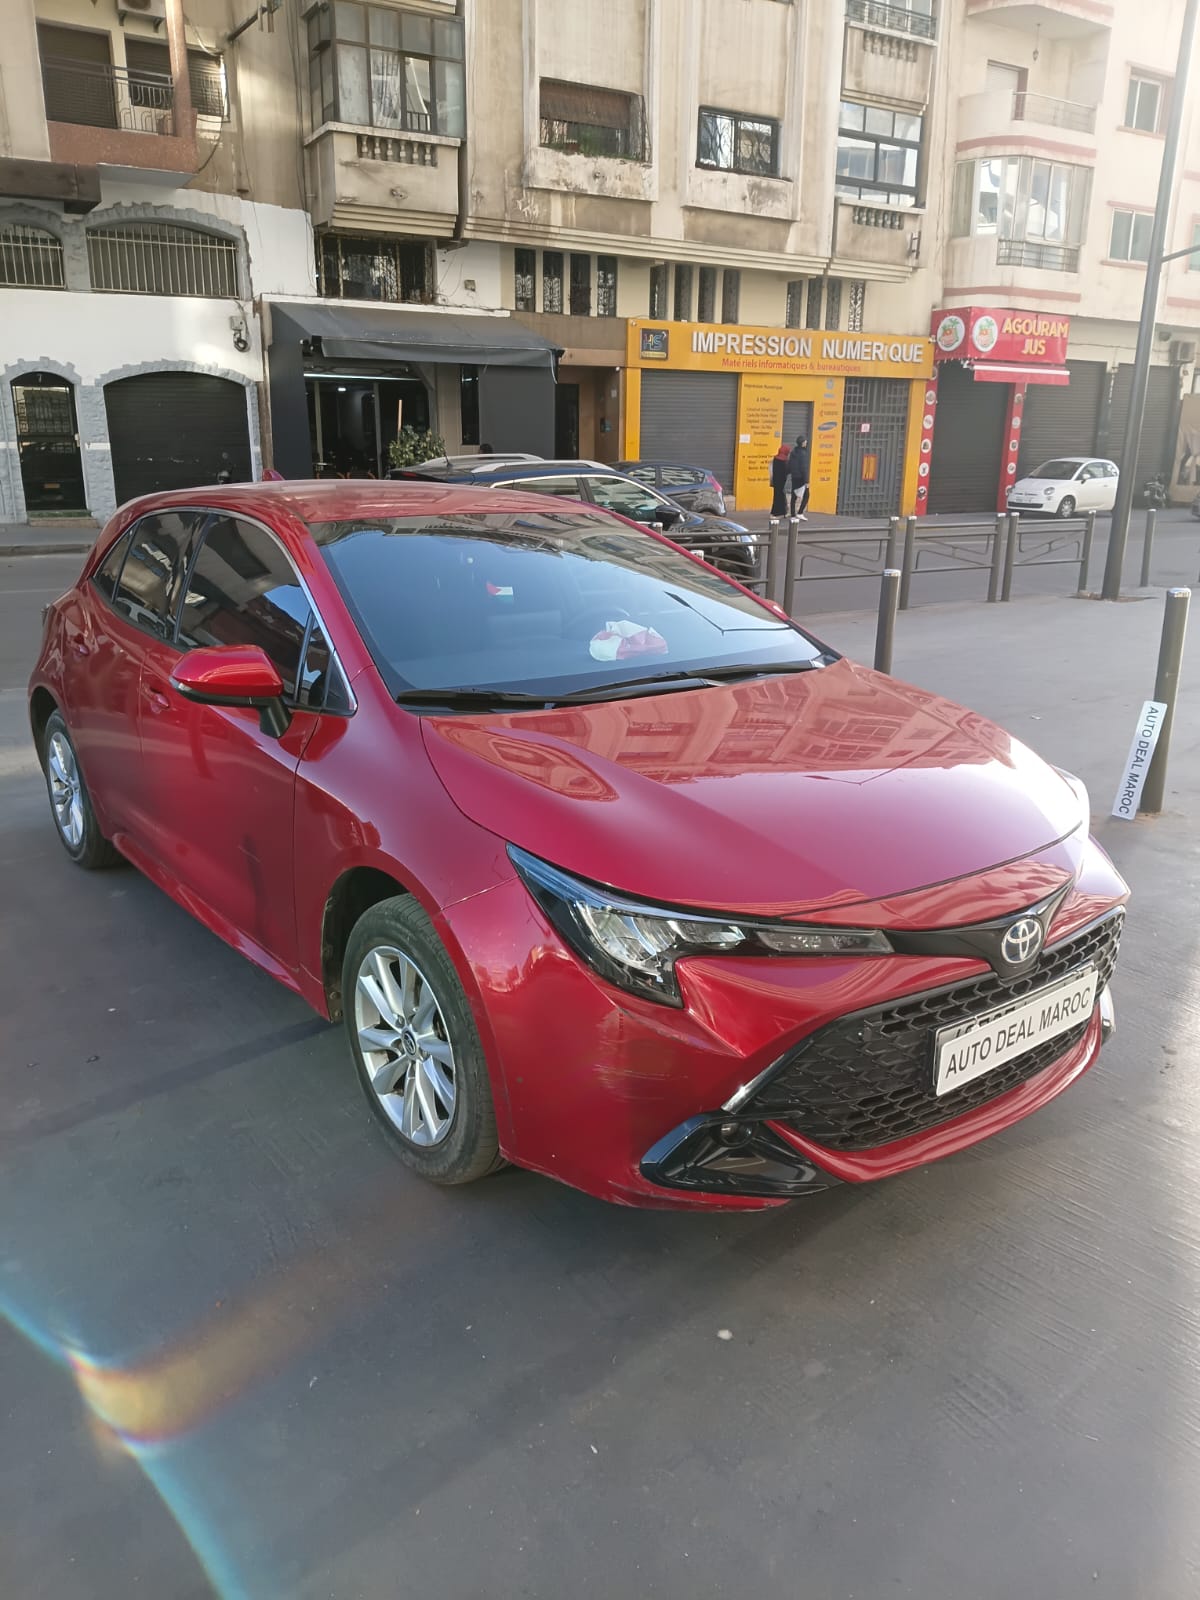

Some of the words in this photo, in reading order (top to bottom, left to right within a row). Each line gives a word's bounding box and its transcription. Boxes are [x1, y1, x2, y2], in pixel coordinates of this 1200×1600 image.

[1002, 317, 1069, 338] AGOURAM
[692, 331, 813, 358] IMPRESSION
[822, 339, 924, 363] NUMERIQUE
[1021, 338, 1046, 355] JUS
[758, 359, 808, 372] informatiques
[1141, 706, 1159, 738] AUTO
[1130, 740, 1150, 769] DEAL
[1118, 772, 1140, 815] MAROC
[945, 1036, 992, 1079] AUTO
[995, 1015, 1035, 1054] DEAL
[1038, 986, 1091, 1032] MAROC
